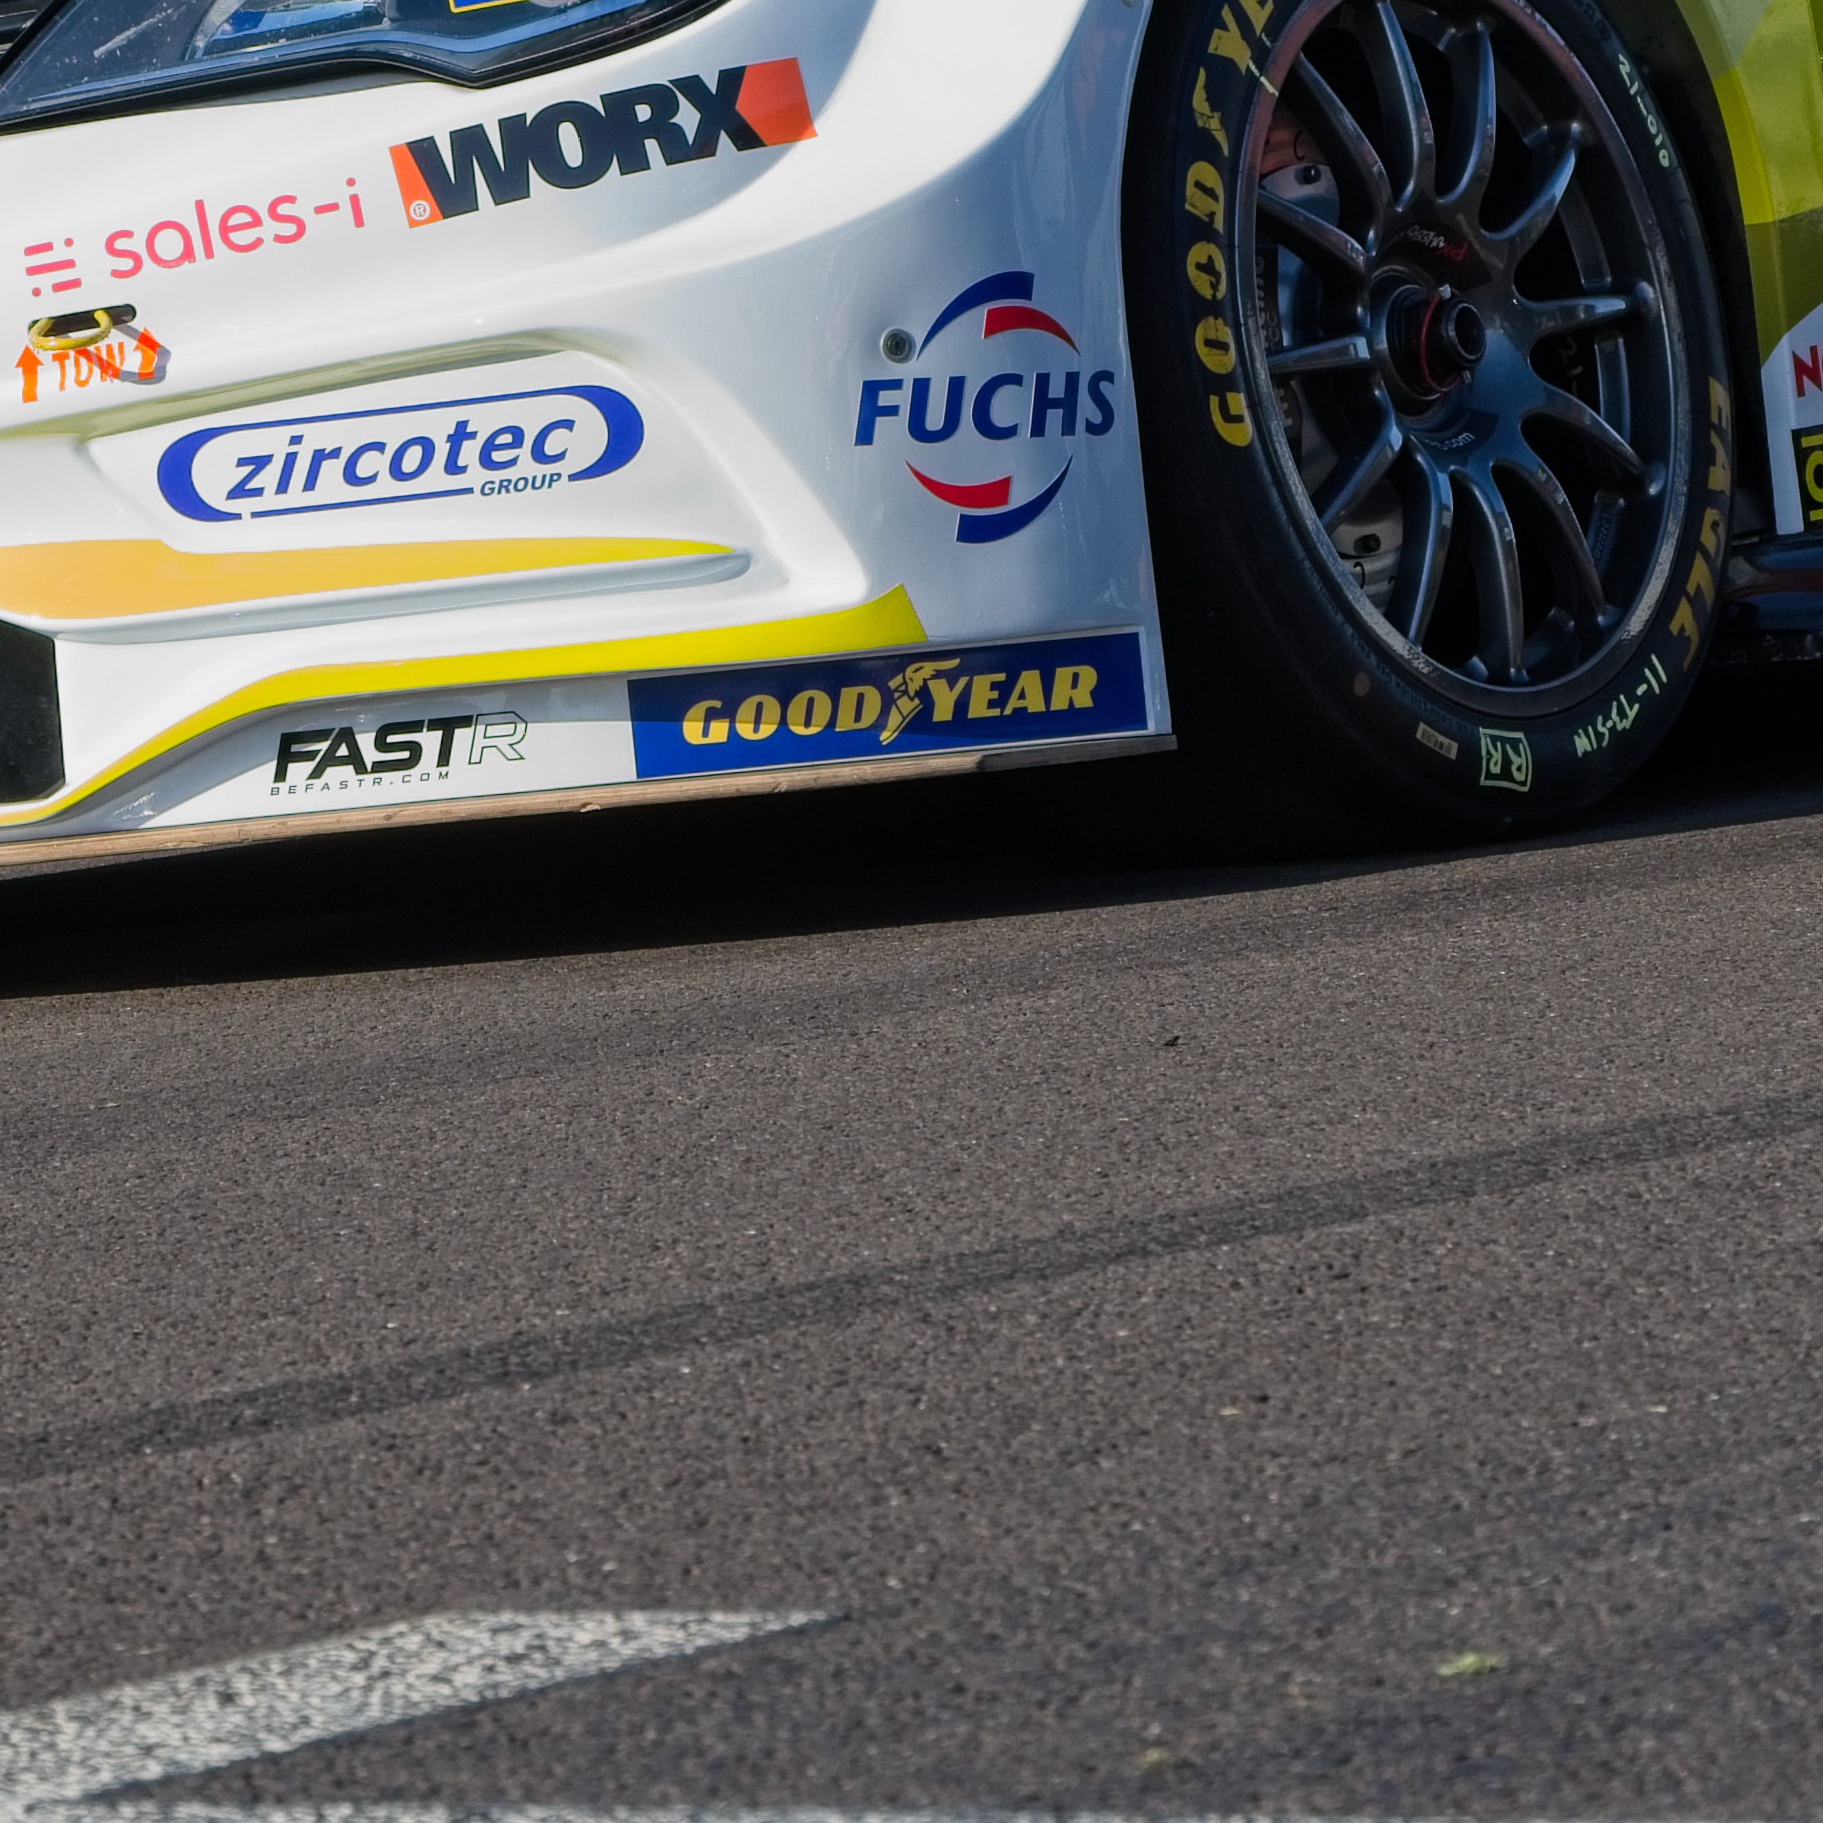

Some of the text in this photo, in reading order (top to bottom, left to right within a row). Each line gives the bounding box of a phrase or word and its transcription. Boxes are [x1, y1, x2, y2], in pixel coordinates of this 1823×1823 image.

[405, 64, 769, 219] WORX
[103, 175, 366, 281] sales-i
[51, 338, 127, 393] TOW
[854, 369, 1116, 447] FUCHS
[225, 417, 579, 501] zircotec
[478, 471, 563, 499] GROUP
[1667, 376, 1730, 673] EAGLE
[270, 768, 451, 797] BEFASTR.COM
[271, 710, 528, 785] FASTR
